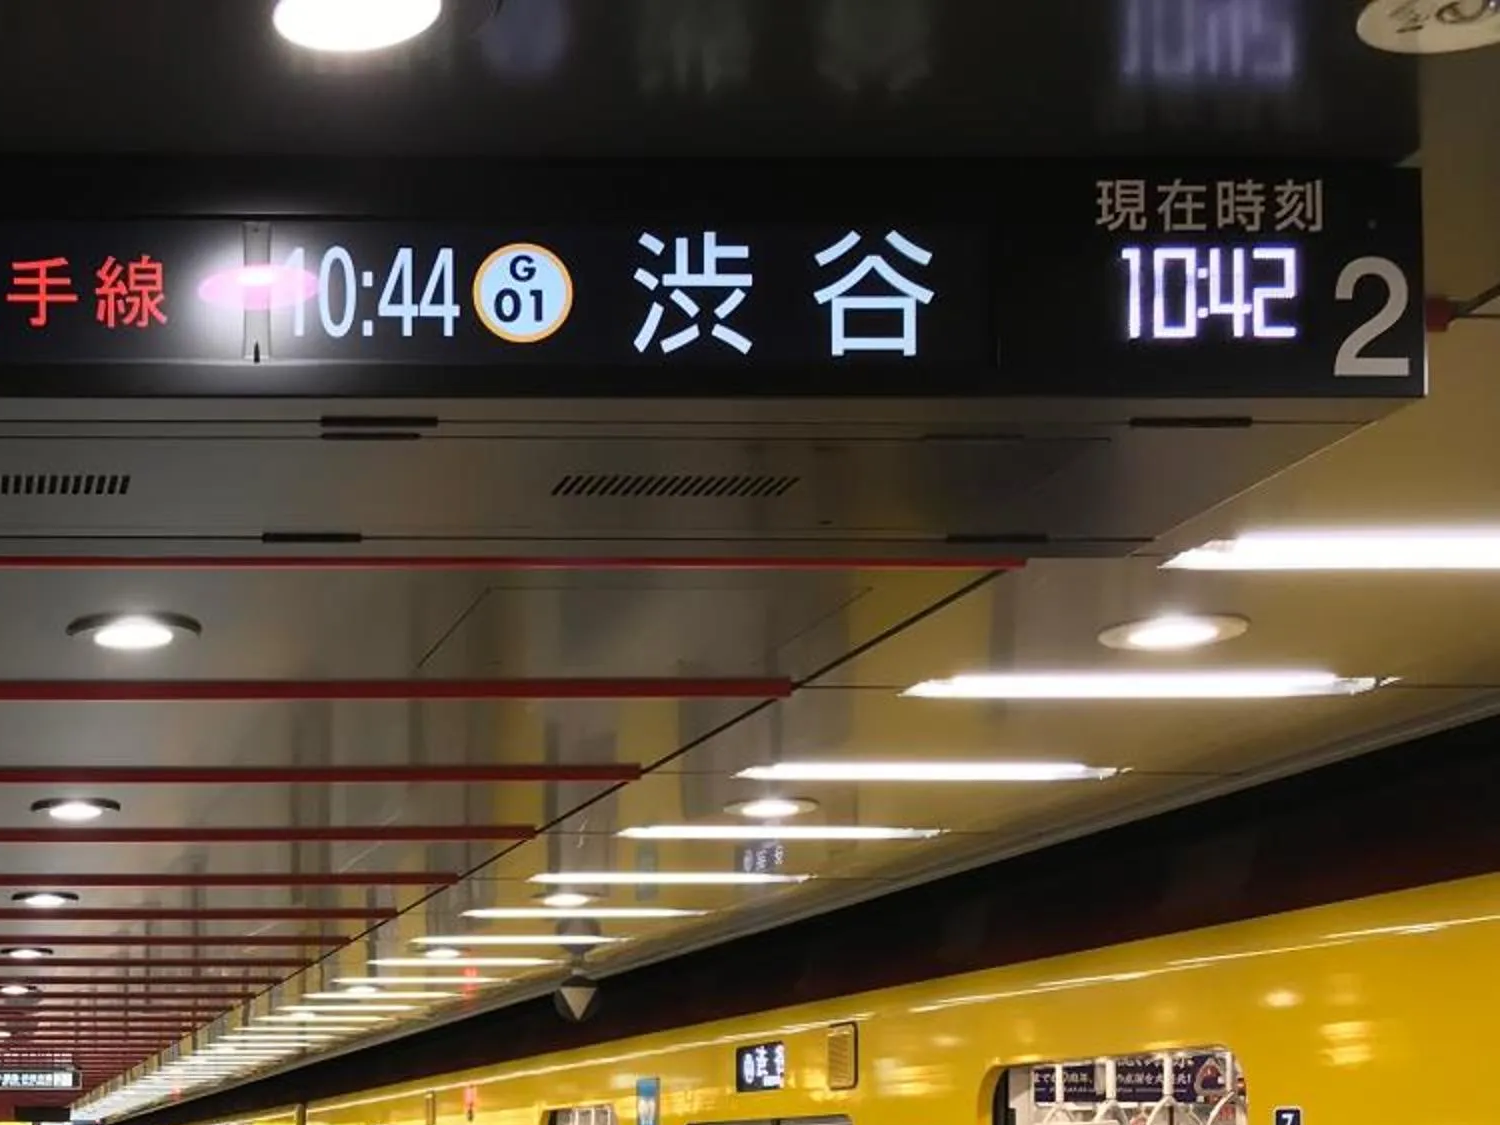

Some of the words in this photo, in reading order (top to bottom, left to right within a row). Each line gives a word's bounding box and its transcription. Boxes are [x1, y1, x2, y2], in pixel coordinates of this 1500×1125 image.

[1096, 178, 1324, 232] 現在時刻
[285, 245, 460, 338] 10:44
[494, 288, 544, 323] 01
[509, 255, 537, 282] G
[632, 230, 935, 357] 渋谷
[1121, 247, 1298, 338] 10:42
[1333, 256, 1410, 376] 2
